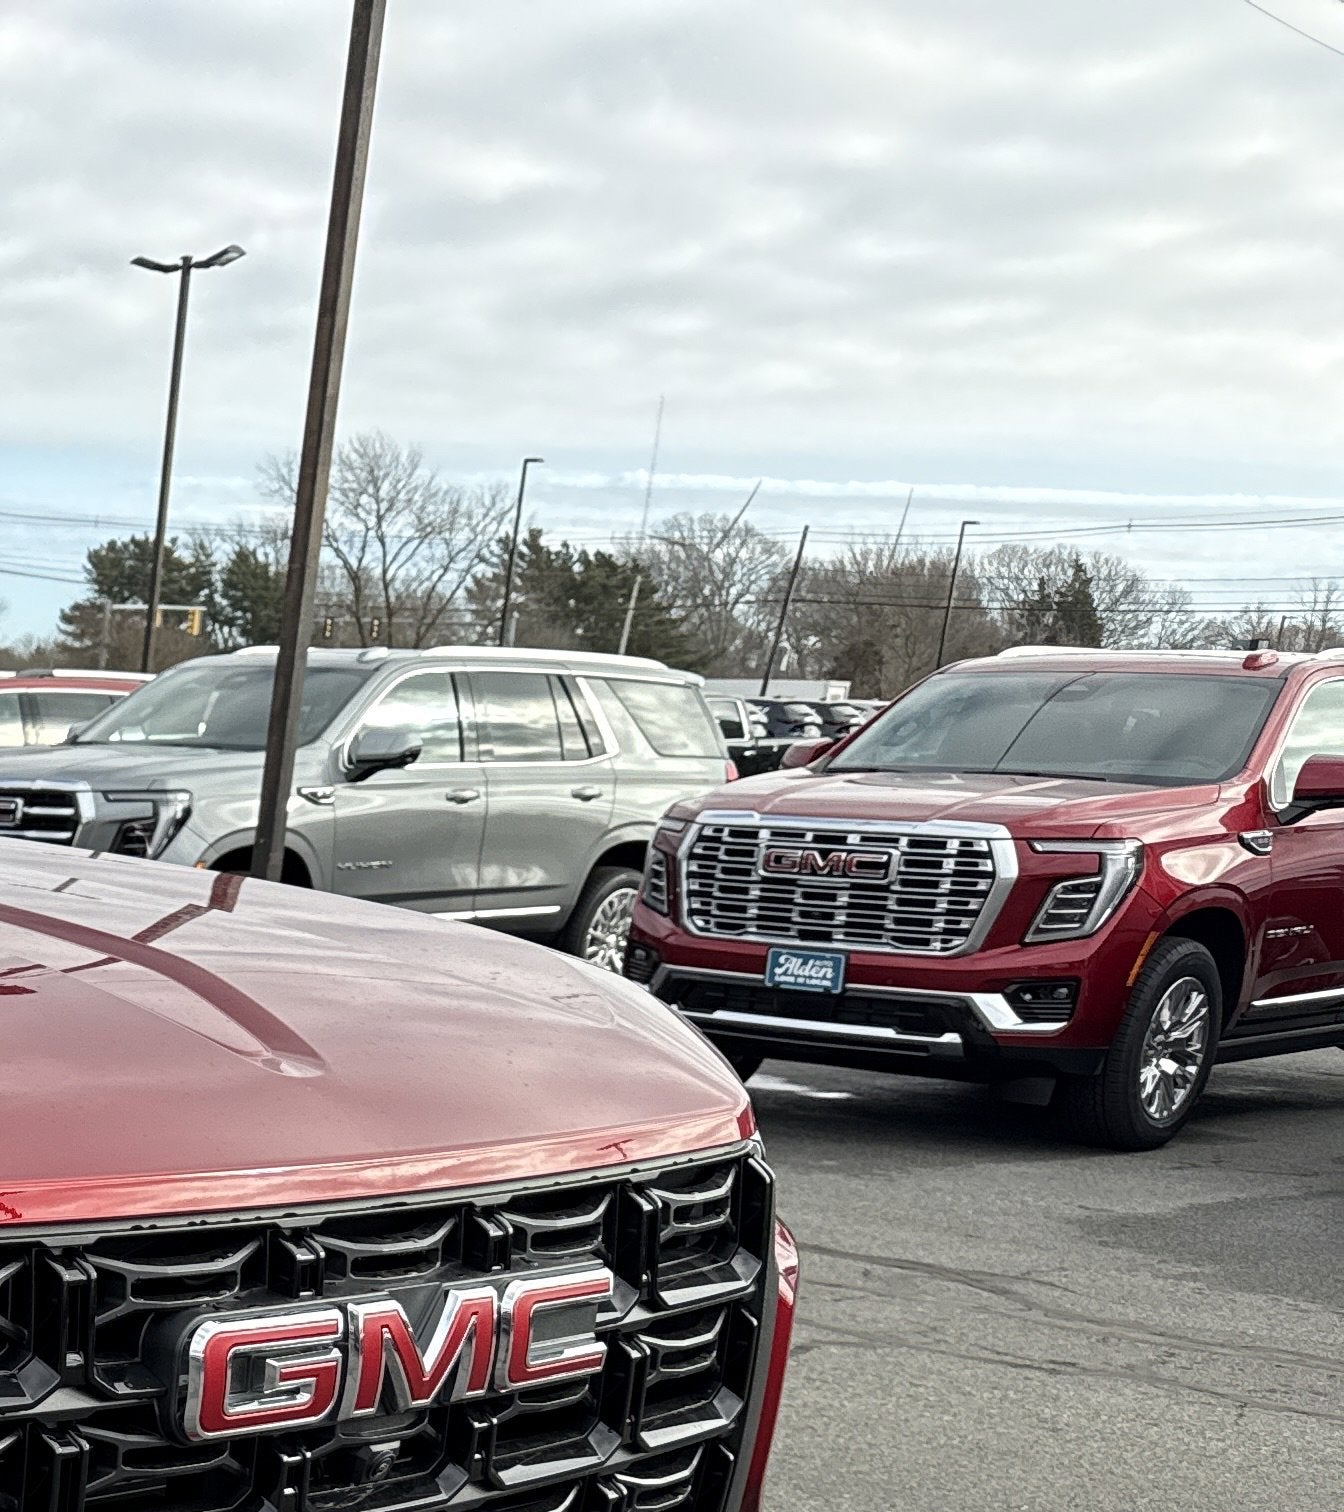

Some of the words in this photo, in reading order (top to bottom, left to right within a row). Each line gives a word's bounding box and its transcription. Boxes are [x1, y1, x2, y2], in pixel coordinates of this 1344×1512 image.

[763, 847, 889, 878] GMC
[774, 954, 834, 979] Alden
[186, 1266, 614, 1441] GMC
